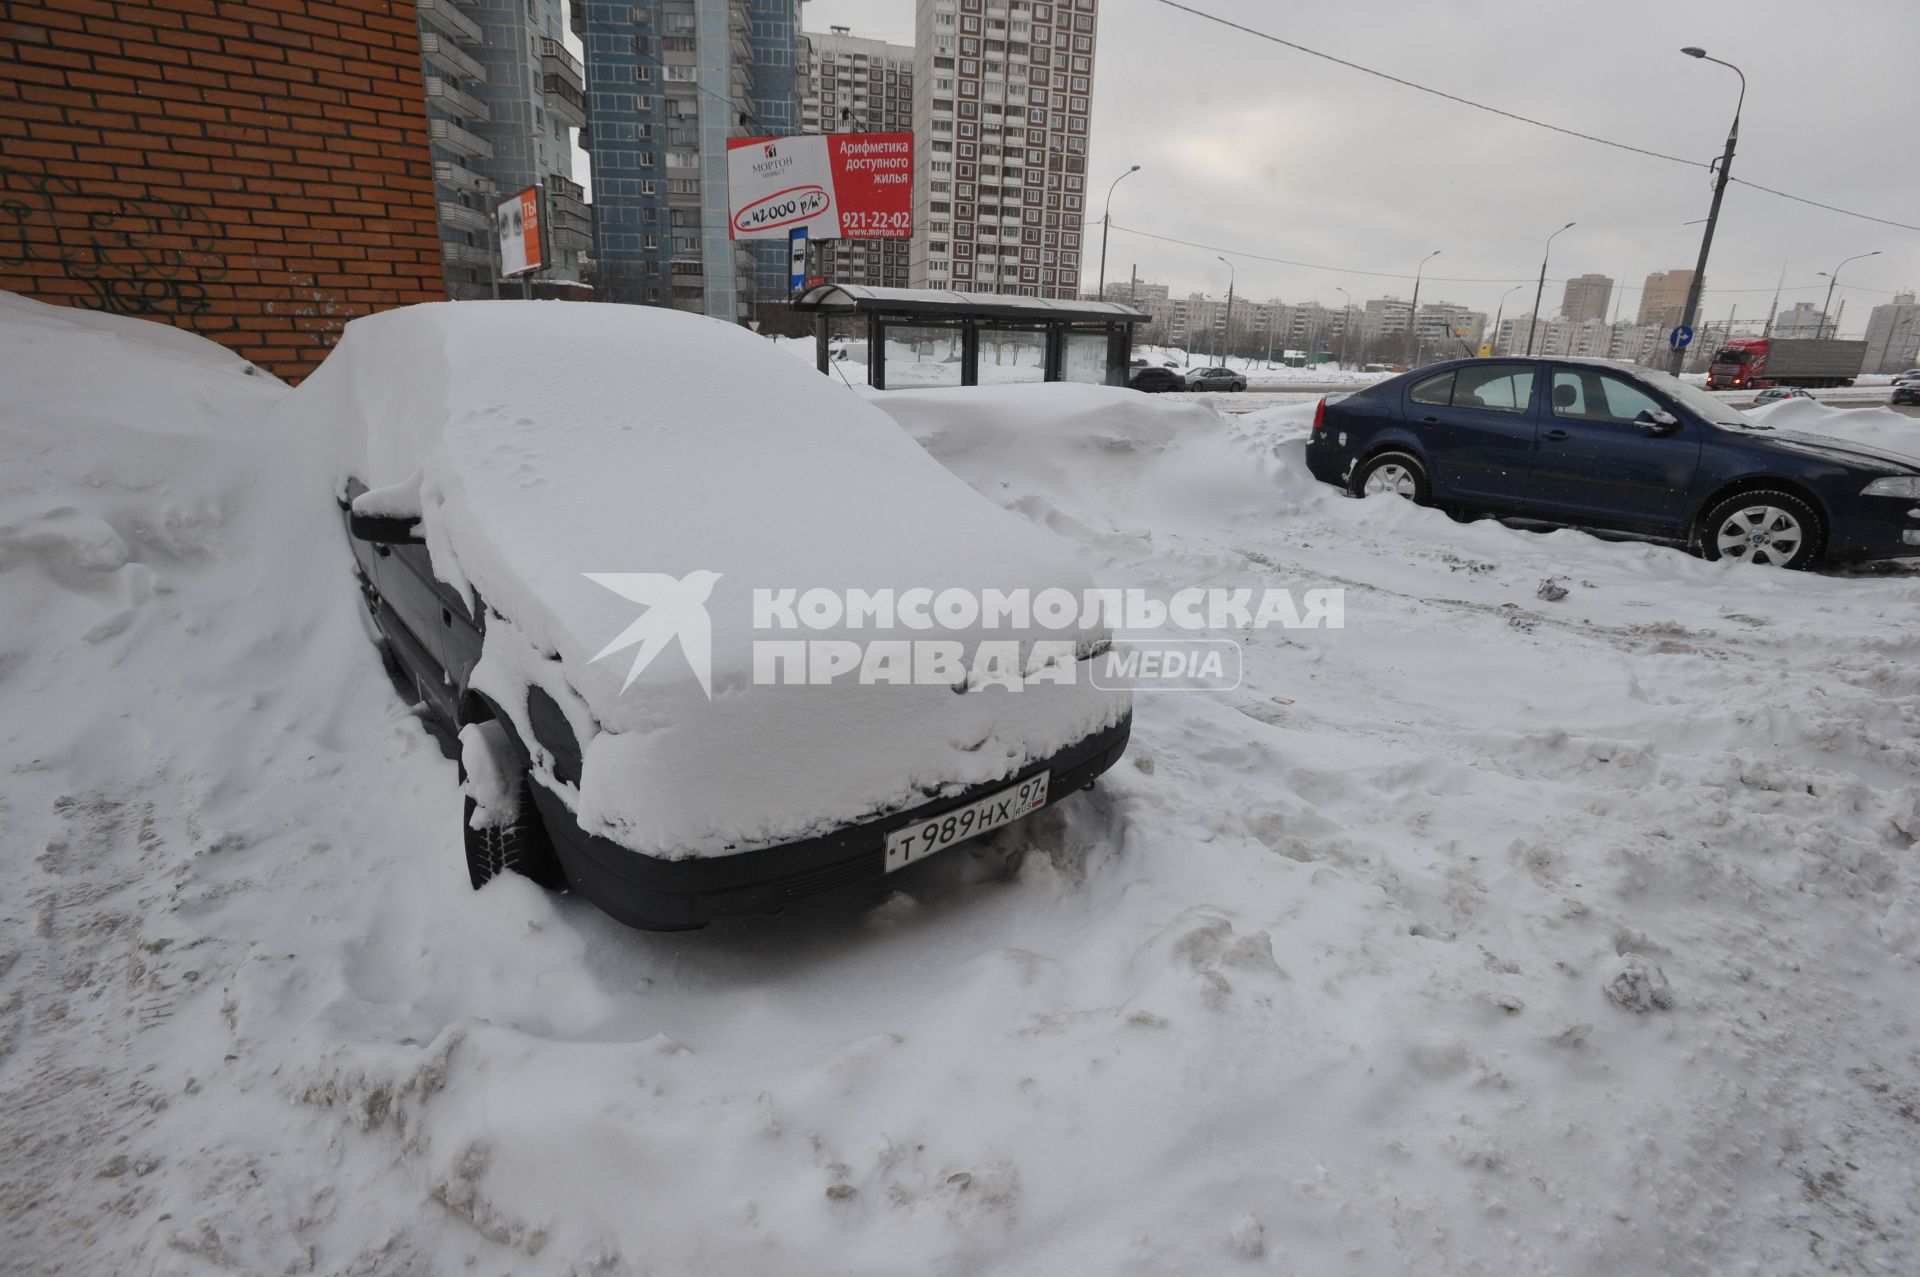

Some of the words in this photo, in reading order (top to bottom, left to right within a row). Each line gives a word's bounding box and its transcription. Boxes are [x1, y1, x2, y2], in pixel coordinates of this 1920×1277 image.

[840, 139, 909, 157] Арифметика
[752, 157, 793, 174] МОРТОН
[845, 157, 909, 172] доступного
[873, 173, 909, 184] жилья
[752, 200, 796, 223] 42000
[842, 211, 910, 229] 921-22-02
[847, 228, 905, 237] www.morton.ru
[1019, 777, 1042, 806] 97
[1015, 802, 1032, 816] RUS
